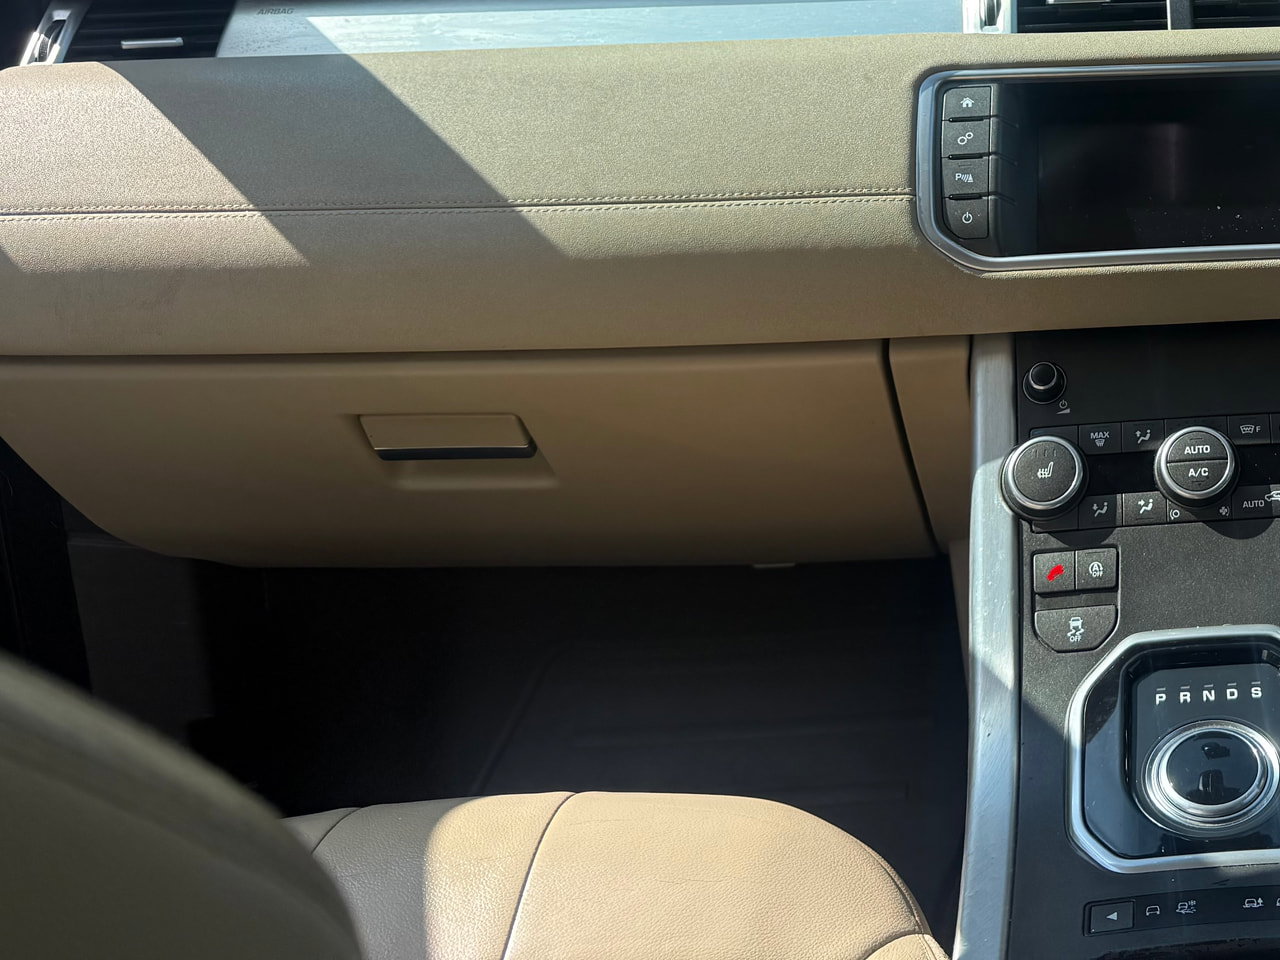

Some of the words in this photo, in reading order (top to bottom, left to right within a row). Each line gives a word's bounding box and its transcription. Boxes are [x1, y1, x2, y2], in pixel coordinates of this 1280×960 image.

[256, 7, 294, 15] AIRBAG
[1090, 431, 1110, 440] MAX
[1184, 444, 1211, 455] AUTO
[1188, 467, 1209, 477] A/C
[1242, 499, 1265, 509] AUTO
[1155, 693, 1167, 706] P
[1179, 691, 1191, 703] R
[1202, 689, 1216, 702] N
[1226, 688, 1238, 700] D
[1250, 686, 1262, 699] S
